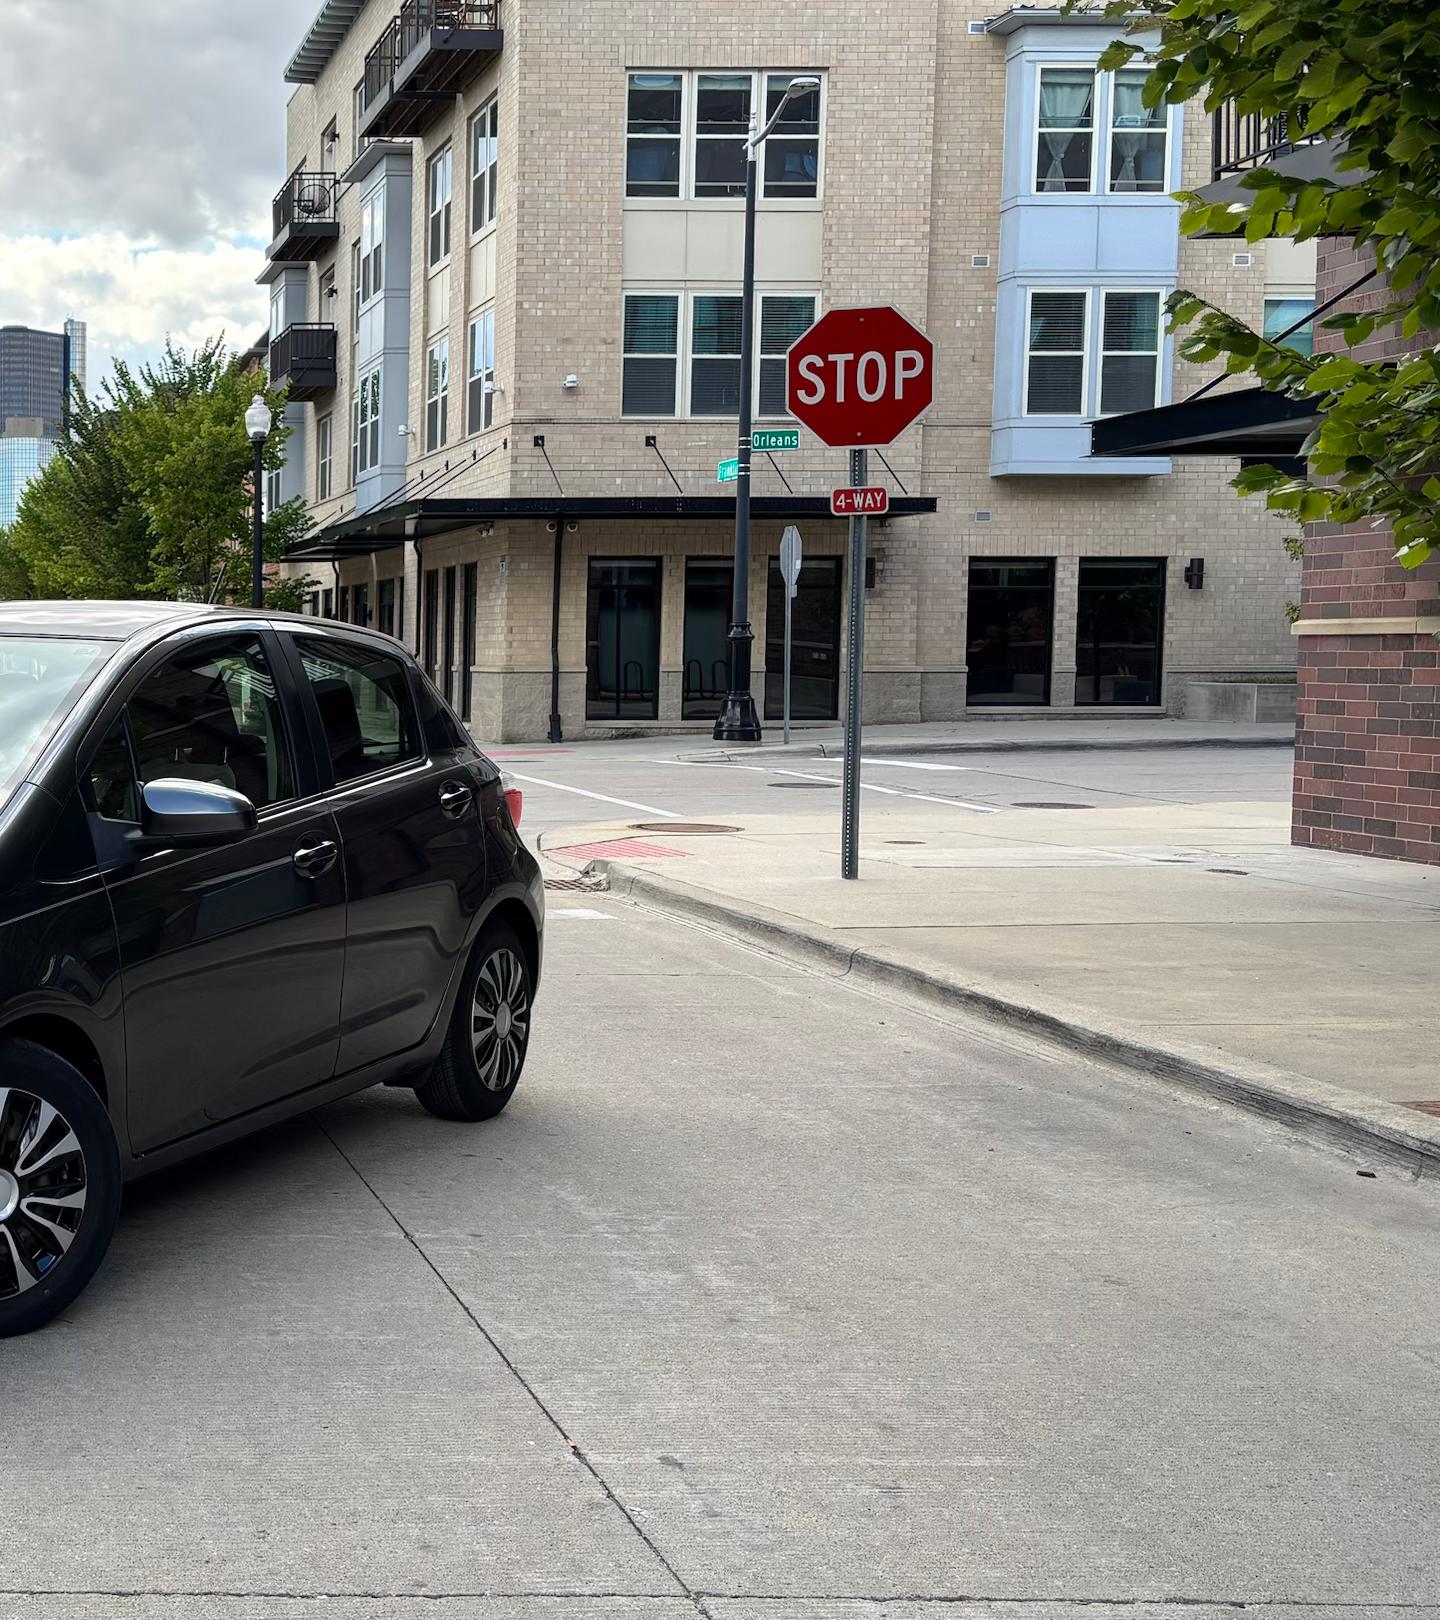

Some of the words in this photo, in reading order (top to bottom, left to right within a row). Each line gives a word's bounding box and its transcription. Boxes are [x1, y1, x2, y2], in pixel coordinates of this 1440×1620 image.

[796, 350, 924, 405] STOP
[753, 434, 797, 447] Orleans
[836, 492, 883, 510] 4-WAY
